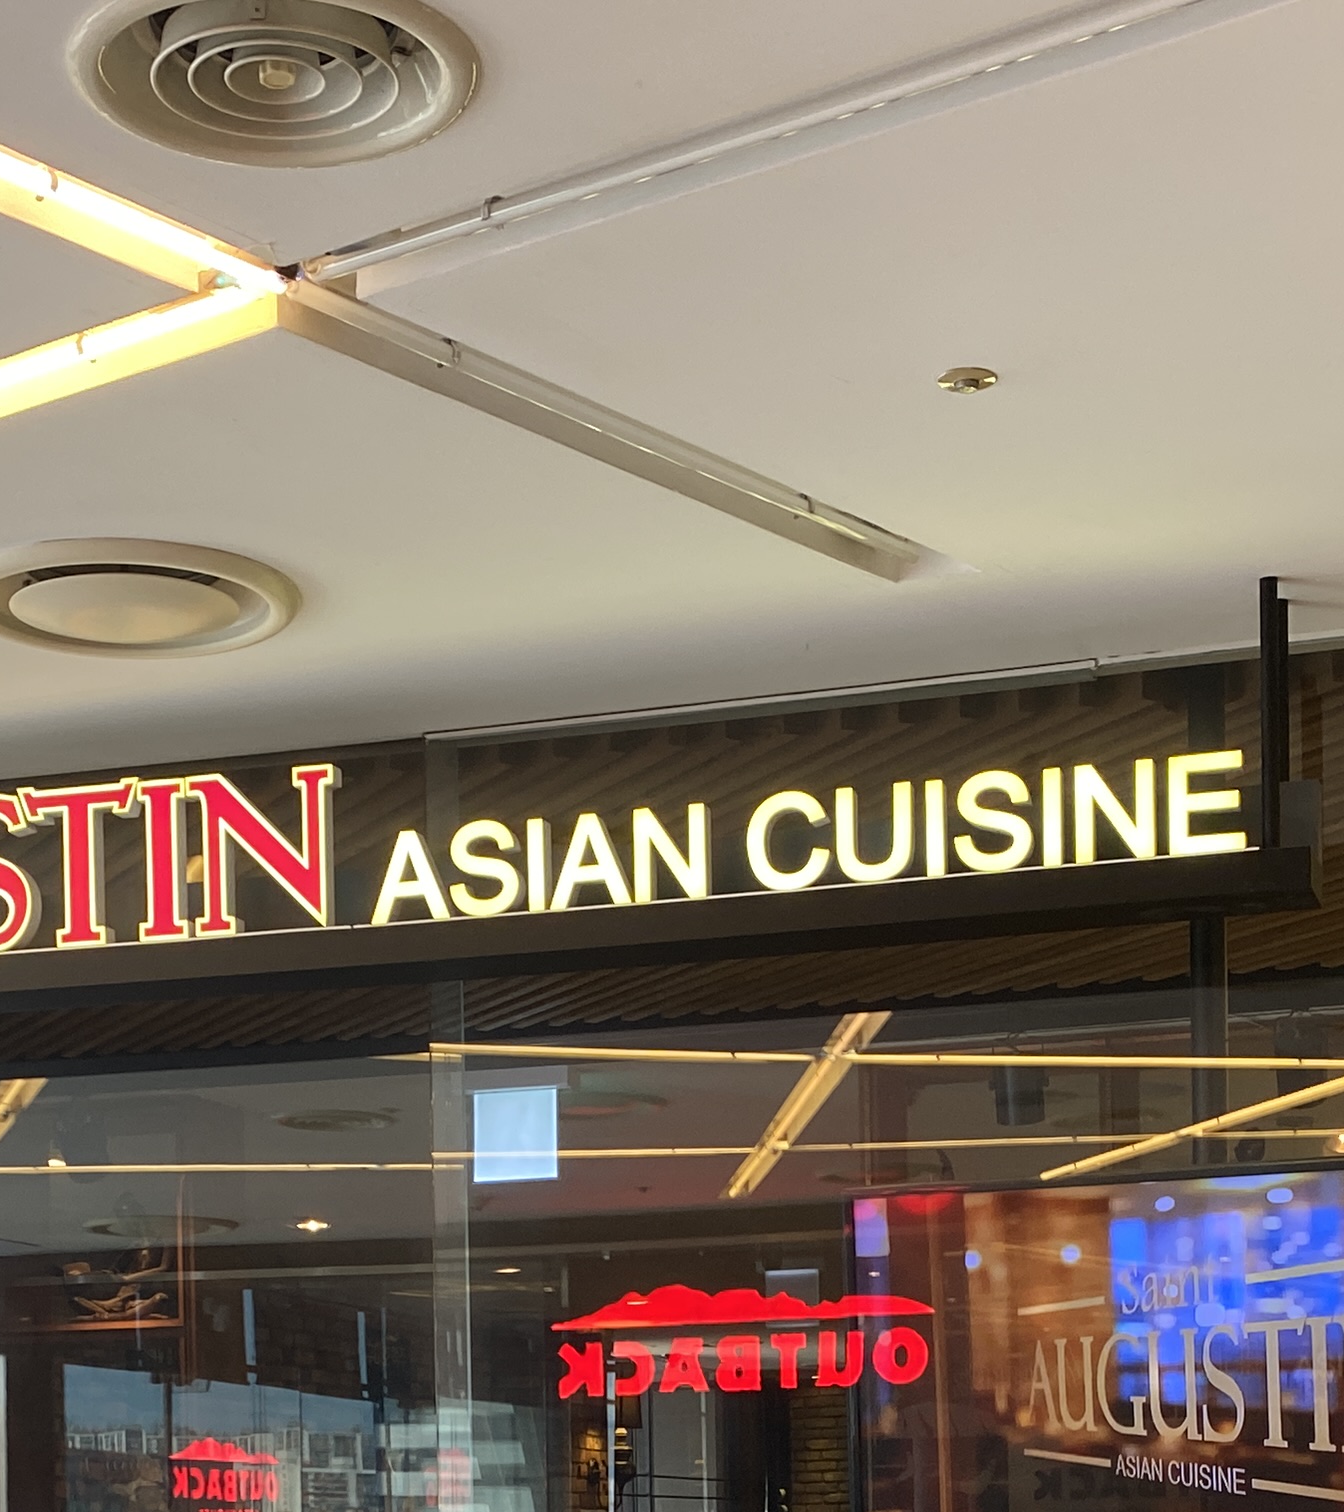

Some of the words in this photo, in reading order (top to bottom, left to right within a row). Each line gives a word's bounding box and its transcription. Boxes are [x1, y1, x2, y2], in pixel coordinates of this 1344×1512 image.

[371, 801, 712, 926] ASIAN
[745, 749, 1248, 891] CUISINE
[1117, 1262, 1216, 1318] Saint
[1114, 1452, 1165, 1485] ASIAN
[1167, 1457, 1248, 1497] CUISINE
